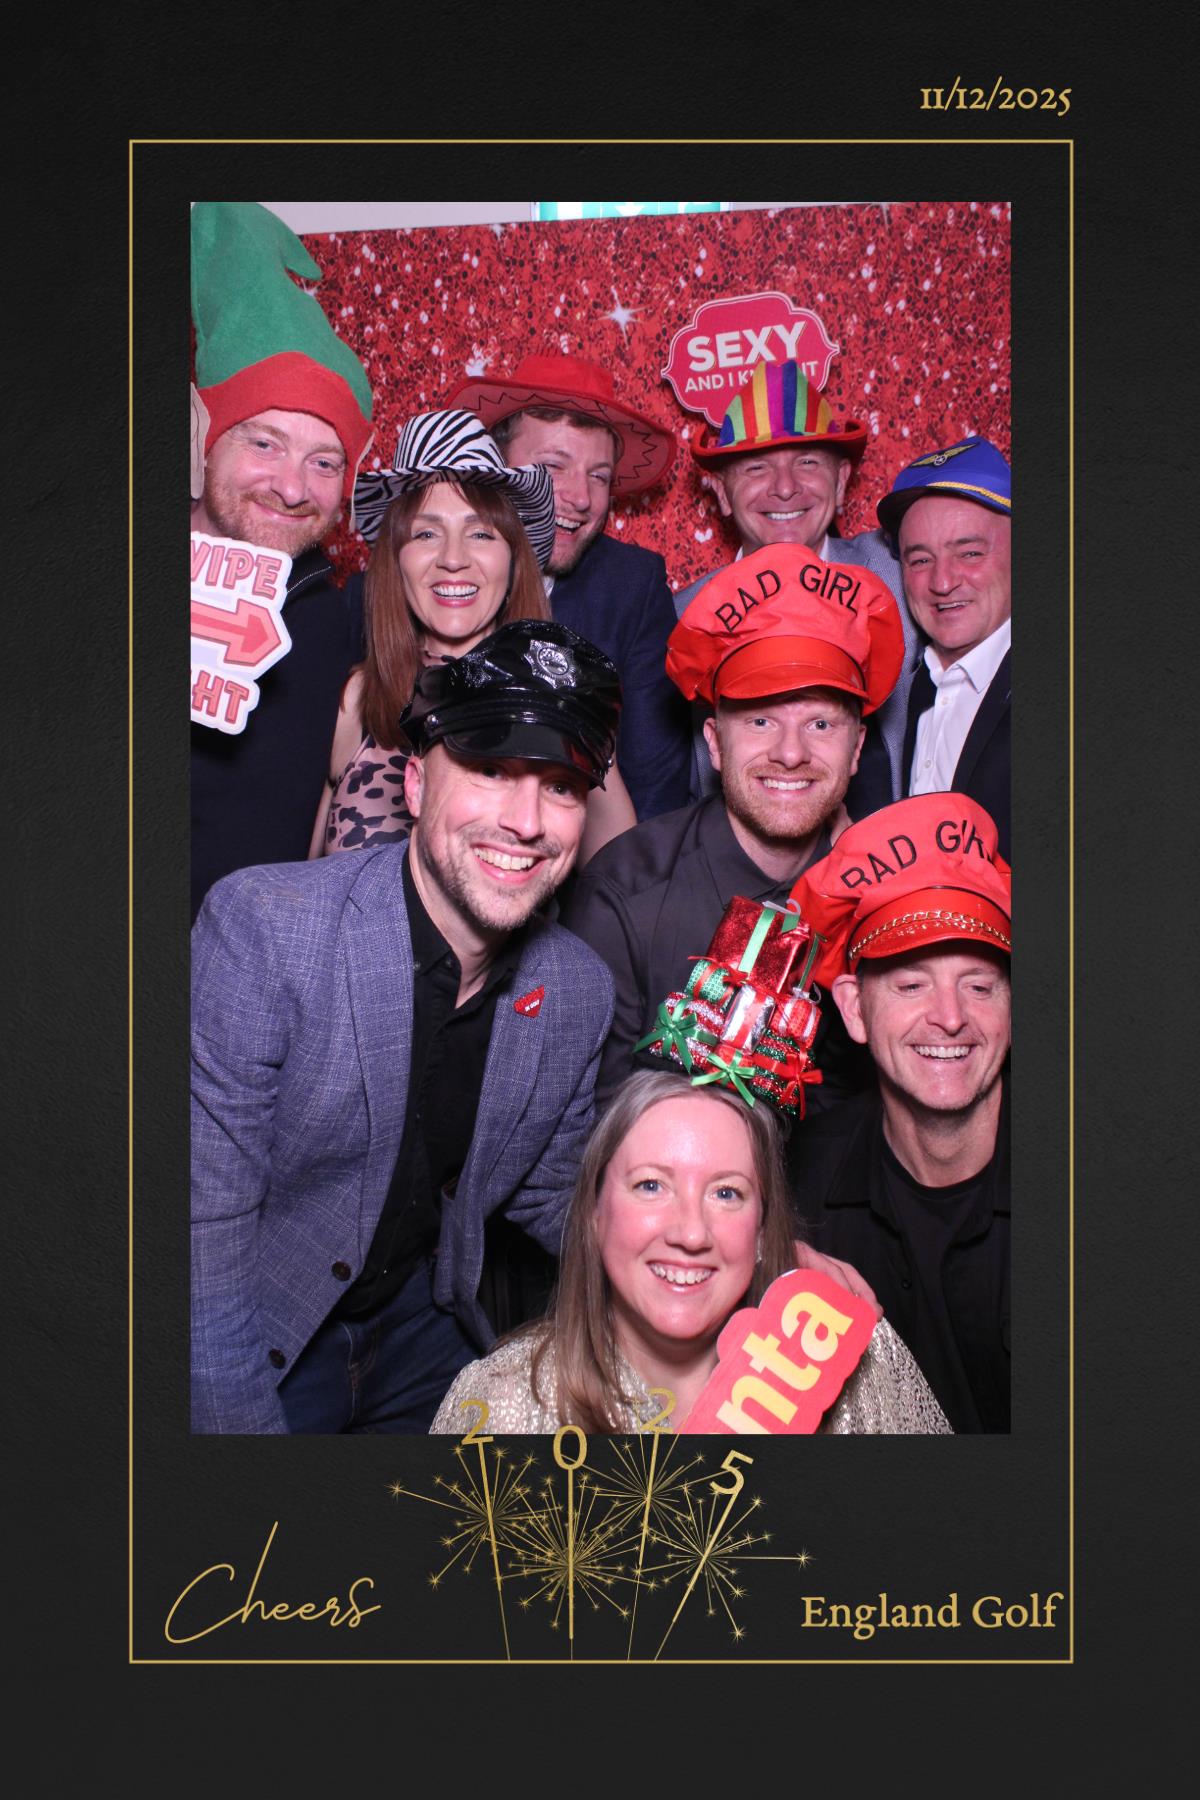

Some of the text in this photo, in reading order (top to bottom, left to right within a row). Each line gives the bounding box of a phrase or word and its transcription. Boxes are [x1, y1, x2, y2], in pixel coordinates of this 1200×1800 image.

[687, 321, 806, 373] SEXY
[685, 374, 725, 393] AND
[728, 371, 734, 387] I
[715, 564, 862, 633] BAD GIRL
